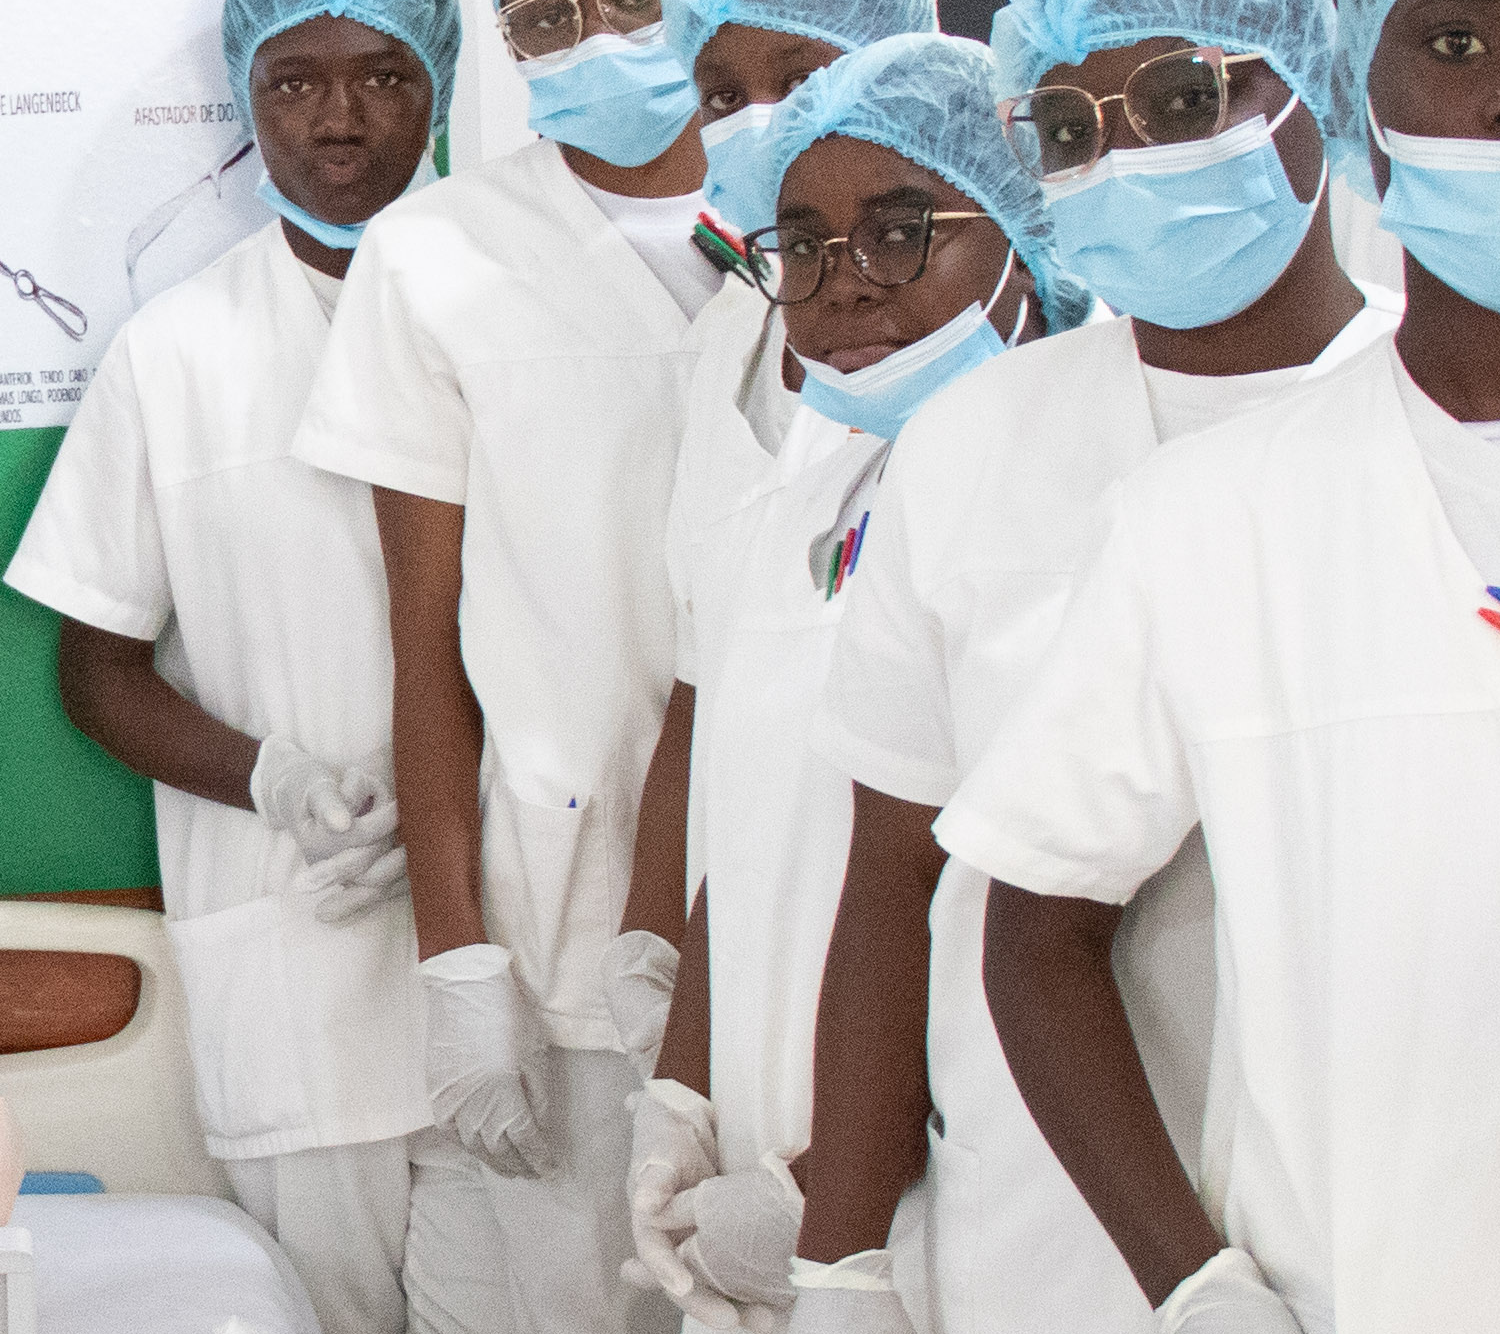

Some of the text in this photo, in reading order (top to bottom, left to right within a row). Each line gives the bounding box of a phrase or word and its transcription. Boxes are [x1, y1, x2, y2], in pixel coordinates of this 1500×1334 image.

[9, 90, 82, 115] LANGENBECK
[134, 103, 215, 126] AFASTADOR DE
[40, 369, 64, 384] TENDO
